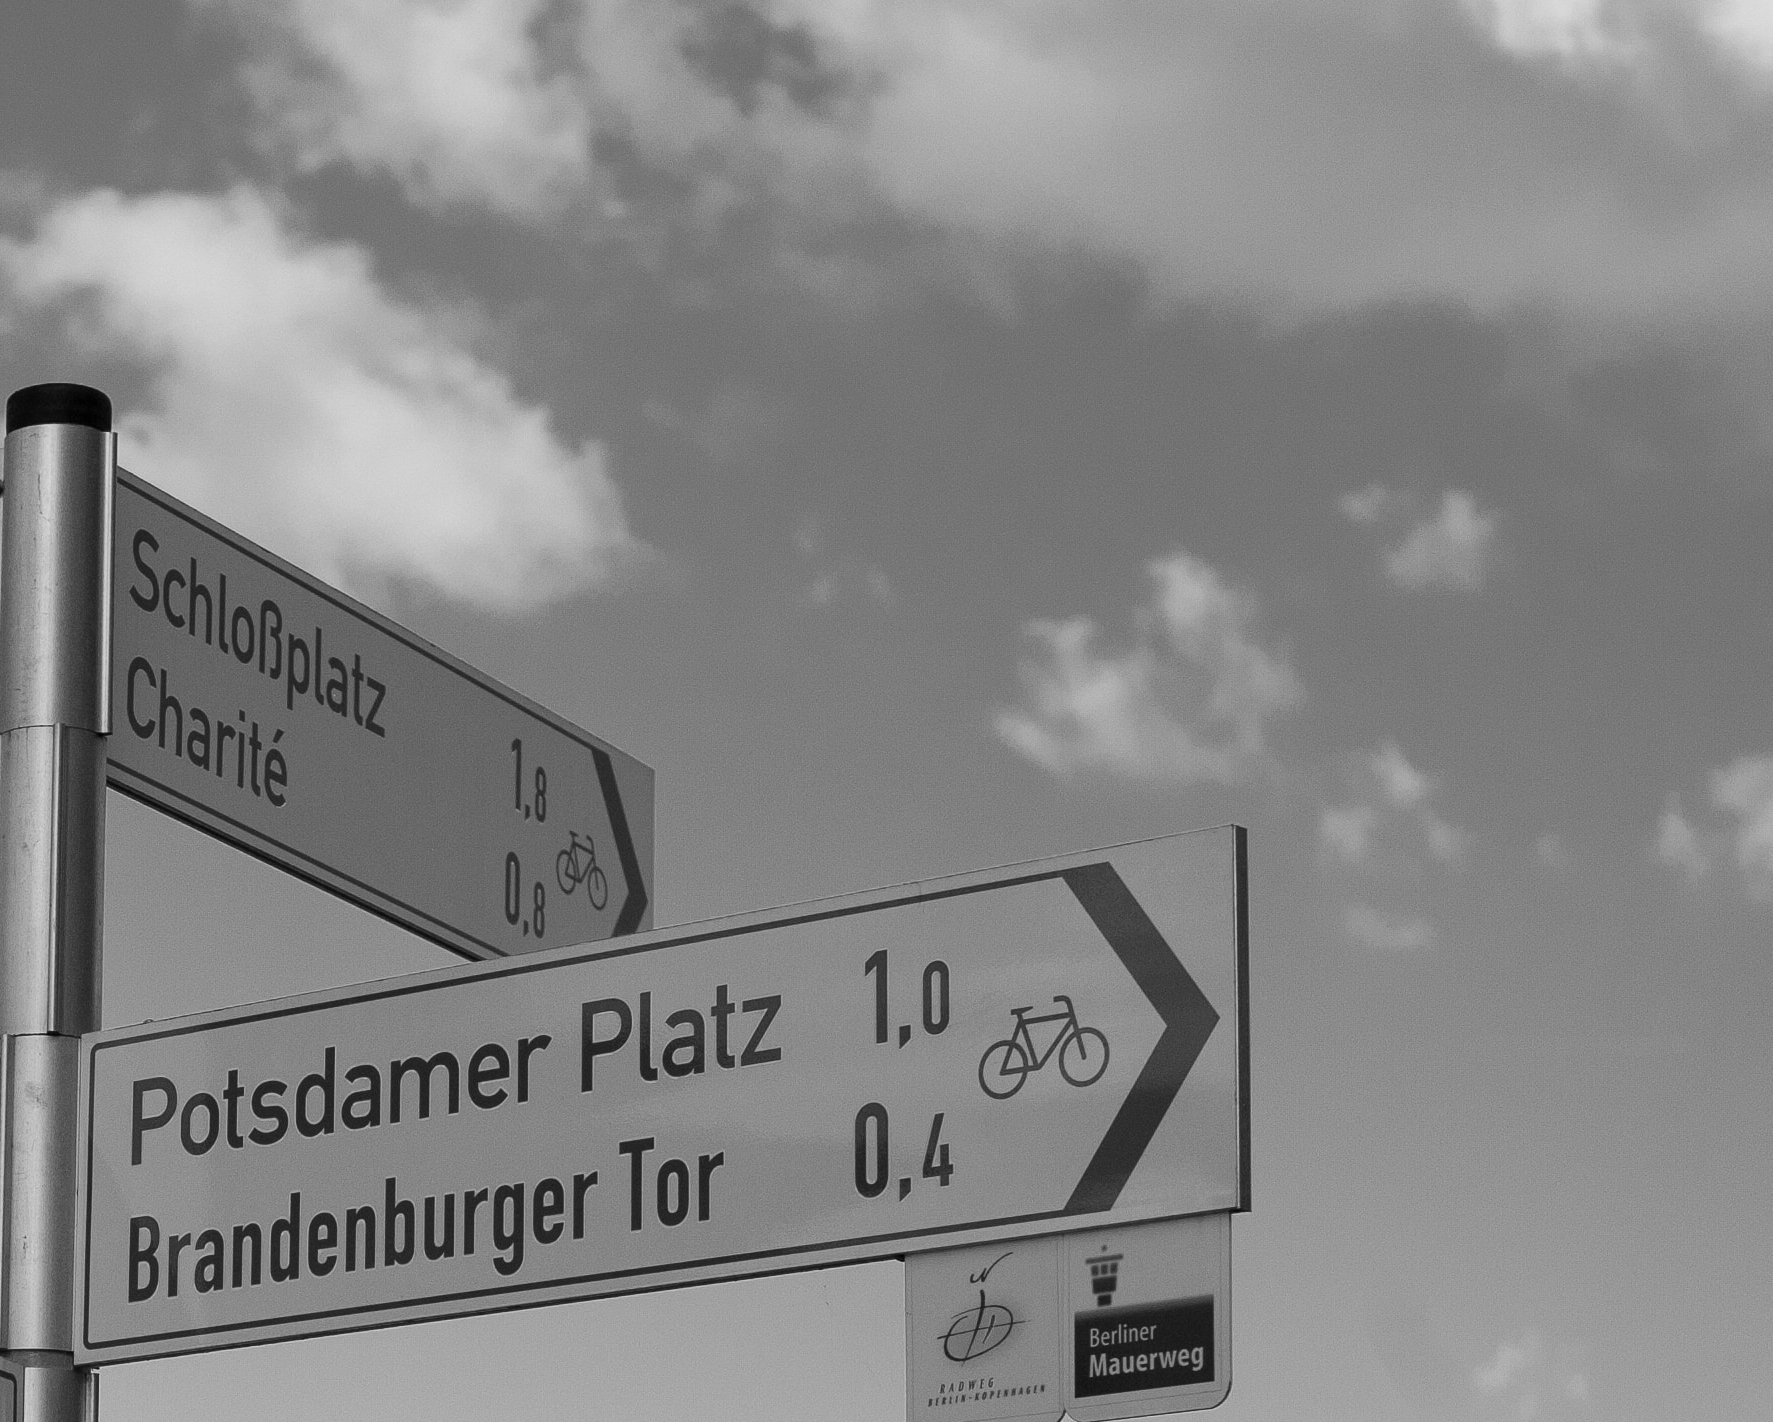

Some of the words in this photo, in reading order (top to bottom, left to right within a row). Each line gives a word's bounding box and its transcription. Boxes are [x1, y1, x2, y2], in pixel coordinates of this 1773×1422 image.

[128, 528, 387, 739] Schloßplatz
[511, 737, 548, 823] 1,8
[126, 656, 288, 807] Charité
[504, 851, 546, 939] 0,8
[131, 1034, 553, 1166] Potsdamer
[580, 984, 782, 1093] Platz
[864, 949, 950, 1050] 1,0
[128, 1170, 599, 1304] Brandenburger
[618, 1136, 725, 1232] Tor
[854, 1102, 954, 1202] 0,4
[939, 1377, 994, 1394] RADWEG
[1089, 1323, 1157, 1348] Berliner
[1089, 1346, 1204, 1378] Mauerweg
